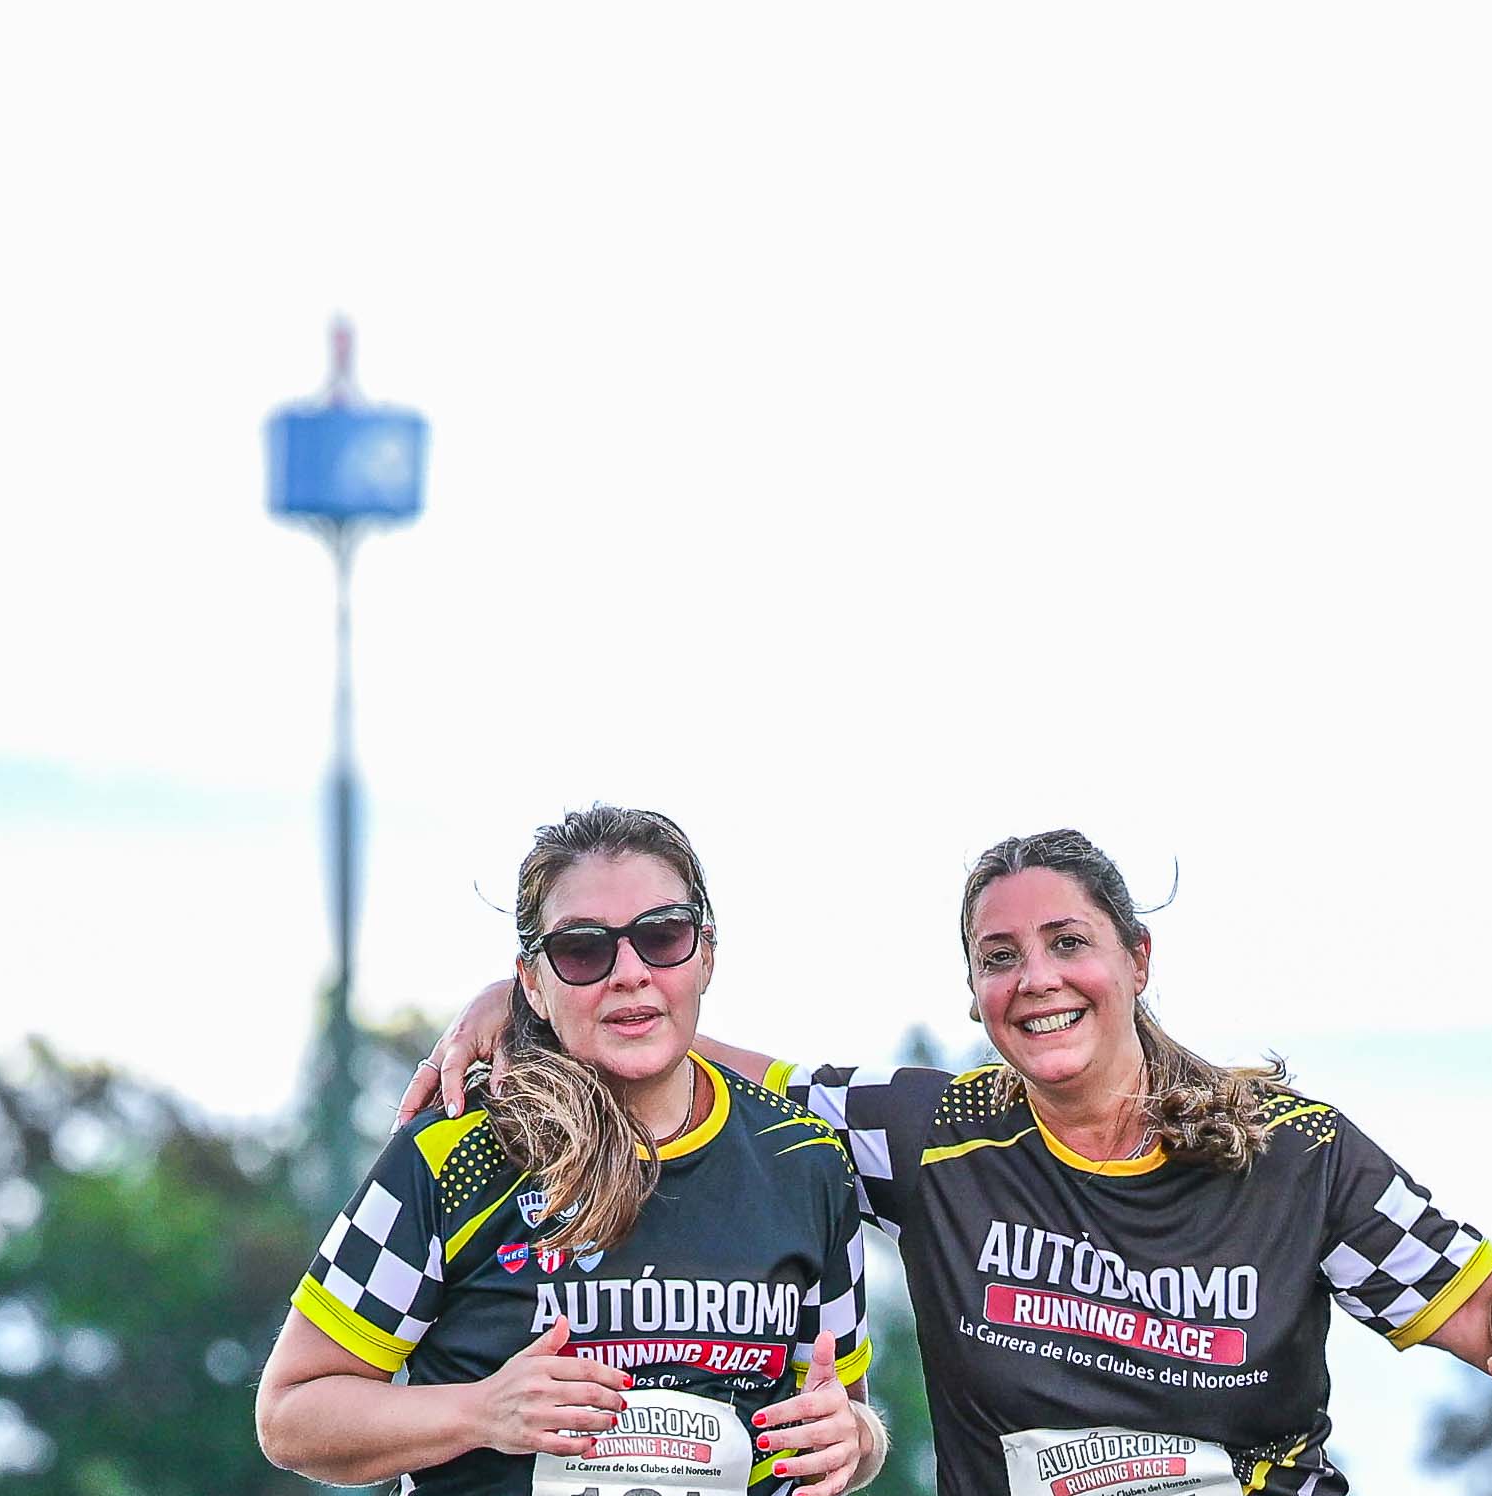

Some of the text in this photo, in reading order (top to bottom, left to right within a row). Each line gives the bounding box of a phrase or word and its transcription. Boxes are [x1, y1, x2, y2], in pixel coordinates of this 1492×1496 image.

[976, 1219, 1258, 1320] AUTÓDROMO
[530, 1265, 800, 1337] AUTÓDROMO
[1013, 1294, 1216, 1360] RUNNING RACE
[706, 1345, 772, 1372] RACE
[959, 1316, 1269, 1390] La Carrera de los Clubes del Noroeste
[565, 1462, 721, 1477] La Carrera de los Clubes del Noroeste
[595, 1438, 697, 1459] RUNNING RACE
[1036, 1432, 1196, 1481] AUTÓDROMO
[1065, 1459, 1171, 1495] RUNNING RACE
[1147, 1483, 1162, 1493] del
[1163, 1477, 1202, 1490] Noroeste
